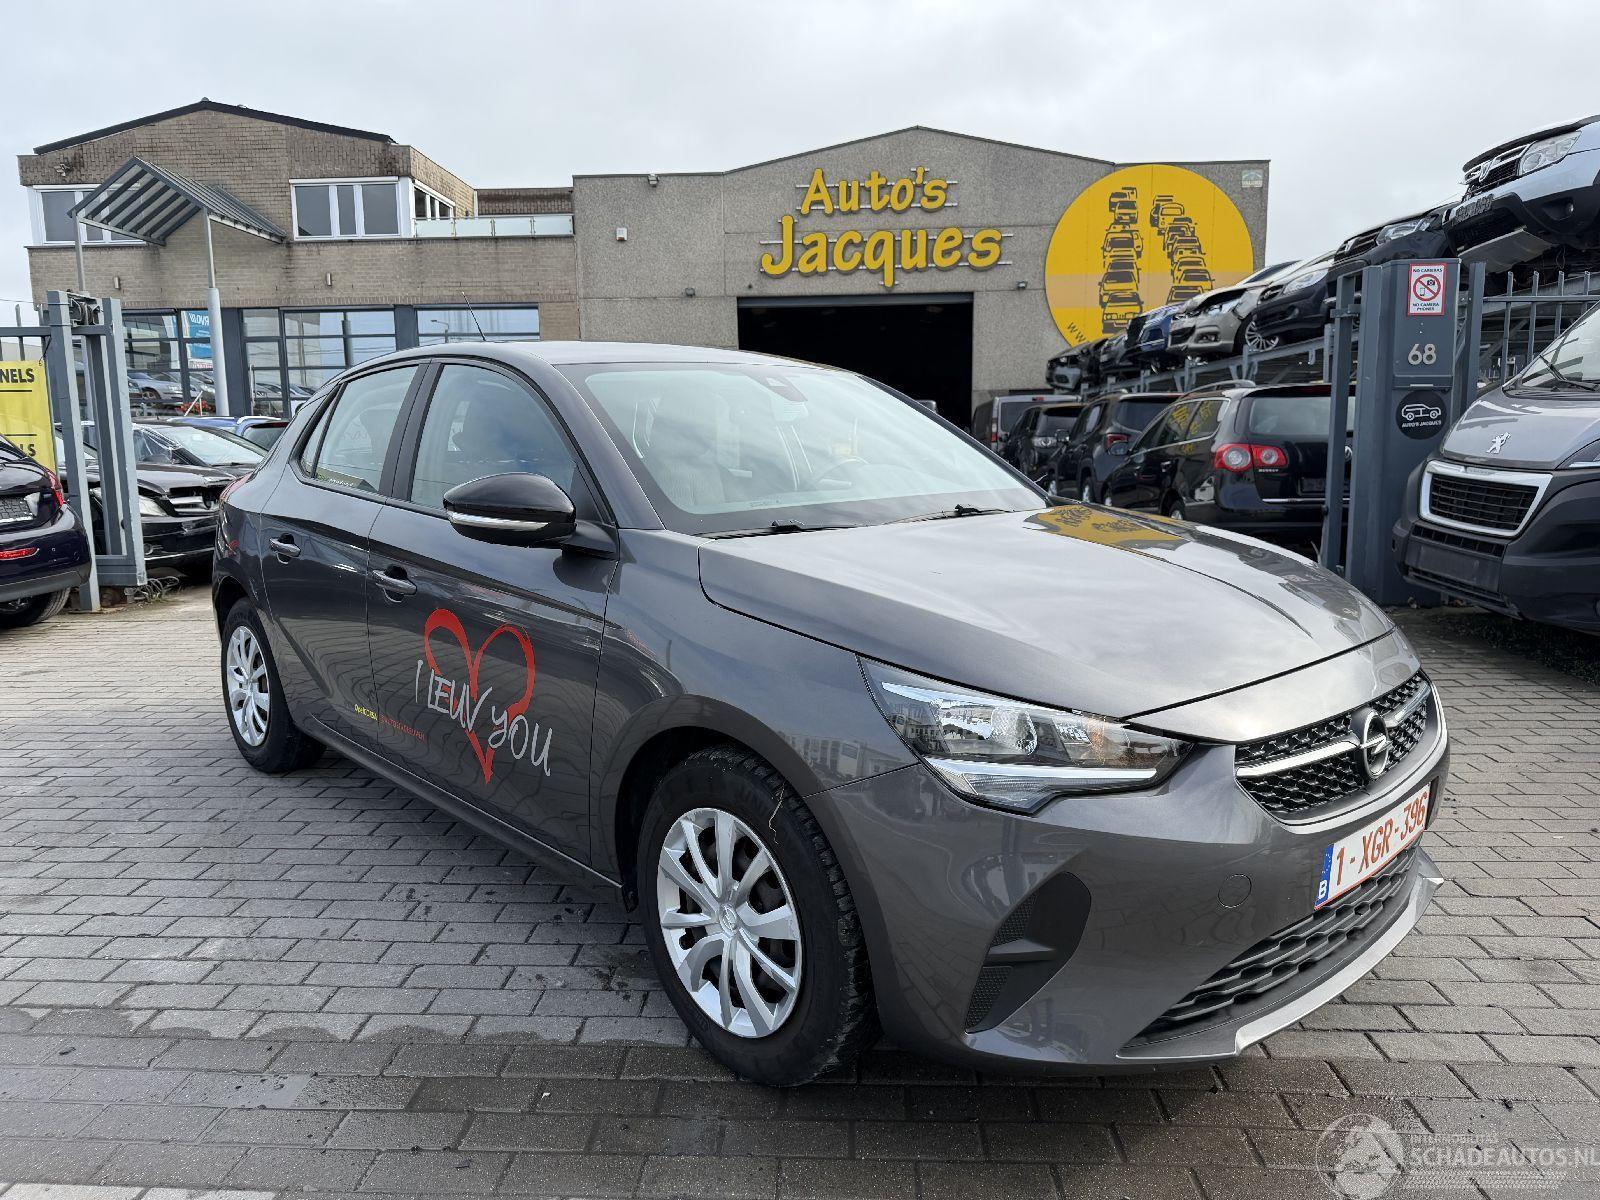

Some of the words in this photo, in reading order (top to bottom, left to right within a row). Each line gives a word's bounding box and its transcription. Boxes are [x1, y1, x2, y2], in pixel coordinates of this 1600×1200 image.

[800, 166, 949, 215] Auto's
[761, 215, 1003, 288] Jacques
[0, 368, 35, 383] NELS
[1407, 343, 1437, 365] 68
[427, 668, 493, 732] LEUV
[1336, 791, 1428, 887] 1-XGR-396
[1318, 879, 1328, 900] B
